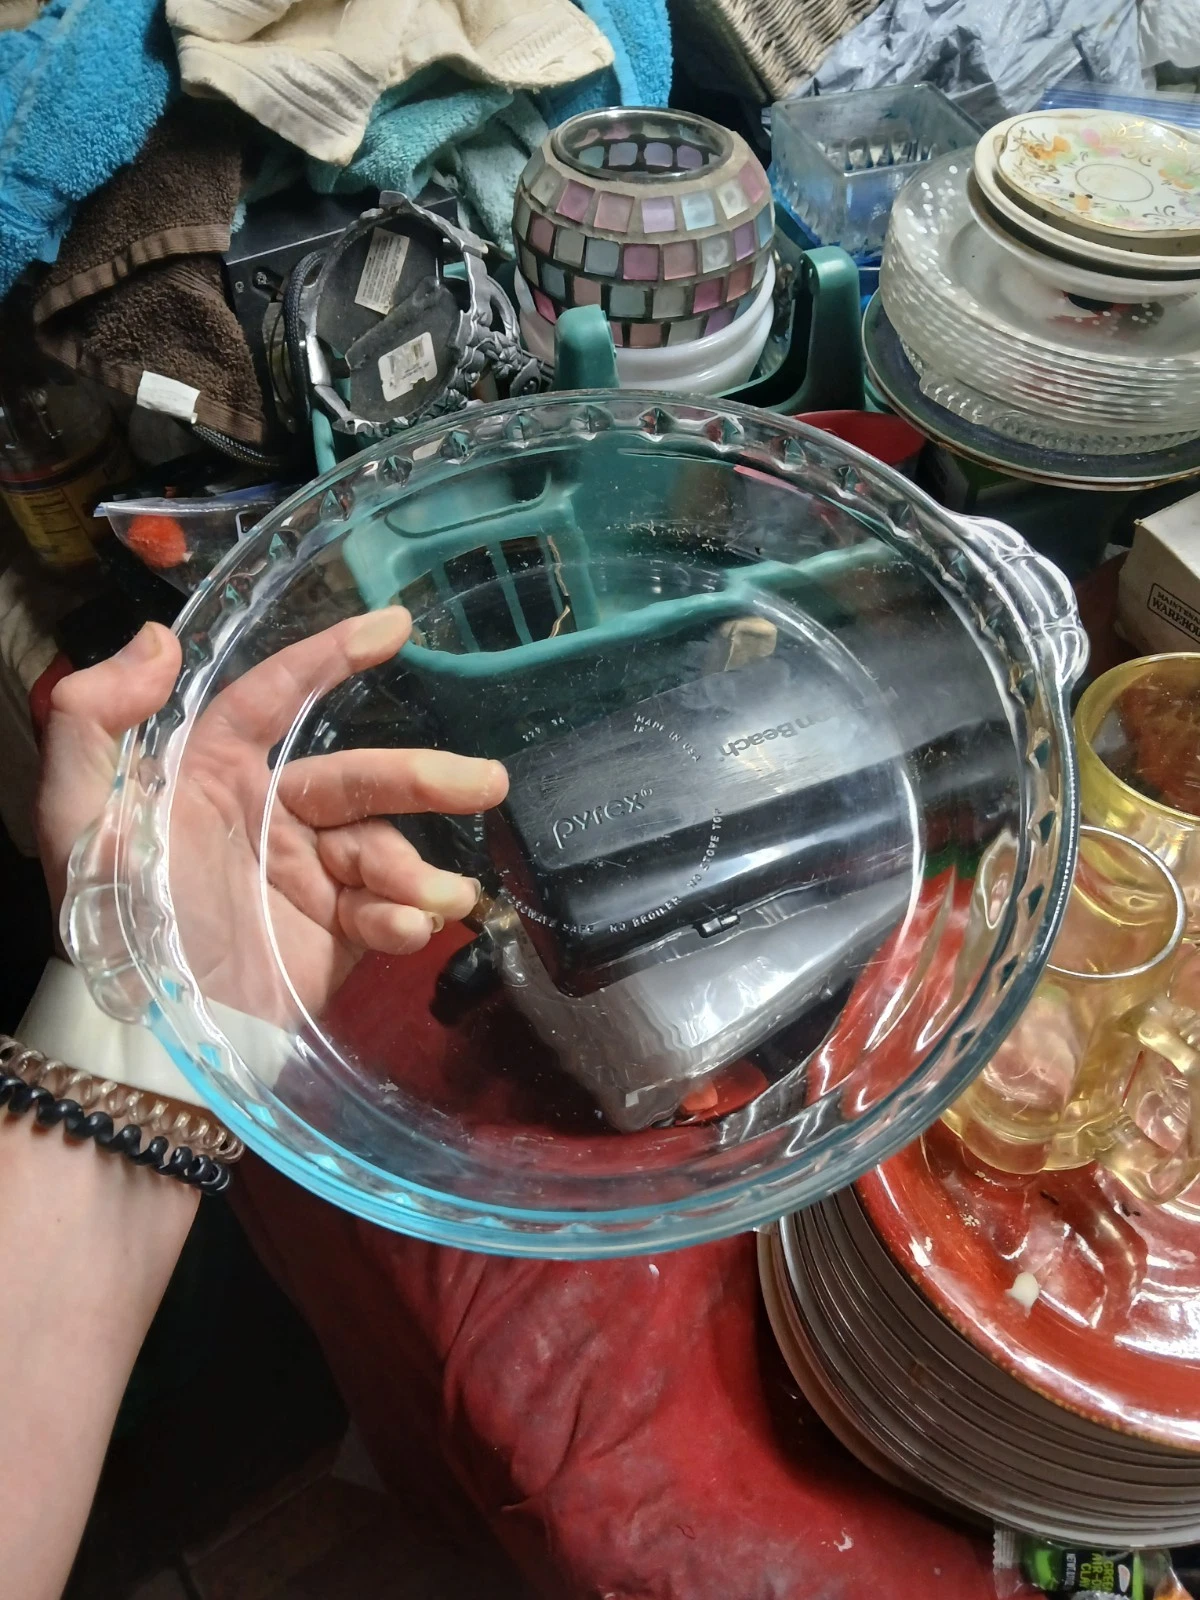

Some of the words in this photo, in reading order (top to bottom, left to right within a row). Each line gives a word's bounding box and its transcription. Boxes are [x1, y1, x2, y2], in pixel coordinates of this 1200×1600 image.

[635, 714, 666, 732] MADE
[668, 731, 682, 743] IN
[718, 721, 798, 757] Beach
[609, 923, 627, 933] NO
[631, 895, 683, 928] BROILER
[686, 873, 702, 889] NO
[700, 834, 720, 872] STOVE
[711, 808, 723, 830] TOP
[1091, 1552, 1103, 1590] AIR-D
